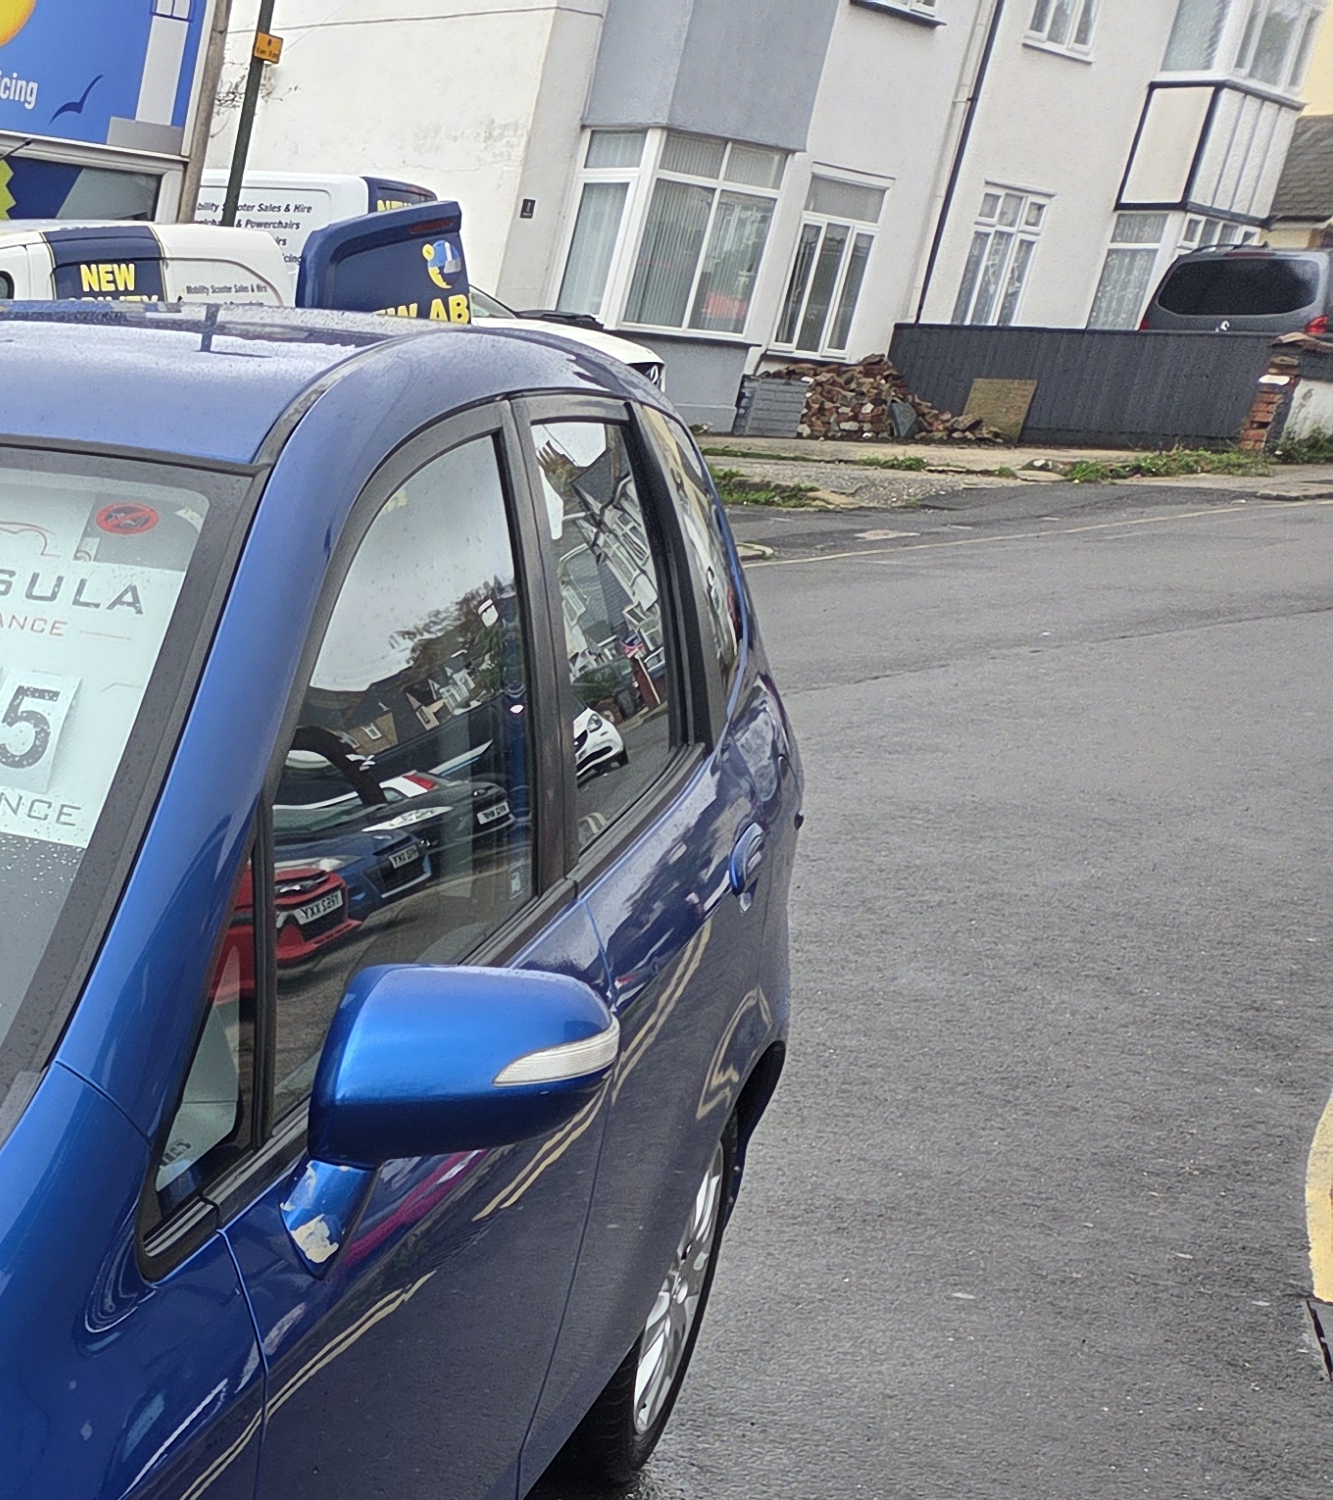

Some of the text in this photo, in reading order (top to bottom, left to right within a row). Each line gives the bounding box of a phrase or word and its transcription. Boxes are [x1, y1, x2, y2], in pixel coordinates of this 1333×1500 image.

[257, 203, 281, 213] Sales
[284, 203, 290, 213] &
[293, 203, 313, 213] Hire
[245, 219, 301, 230] Powerchairs
[80, 263, 135, 292] NEW
